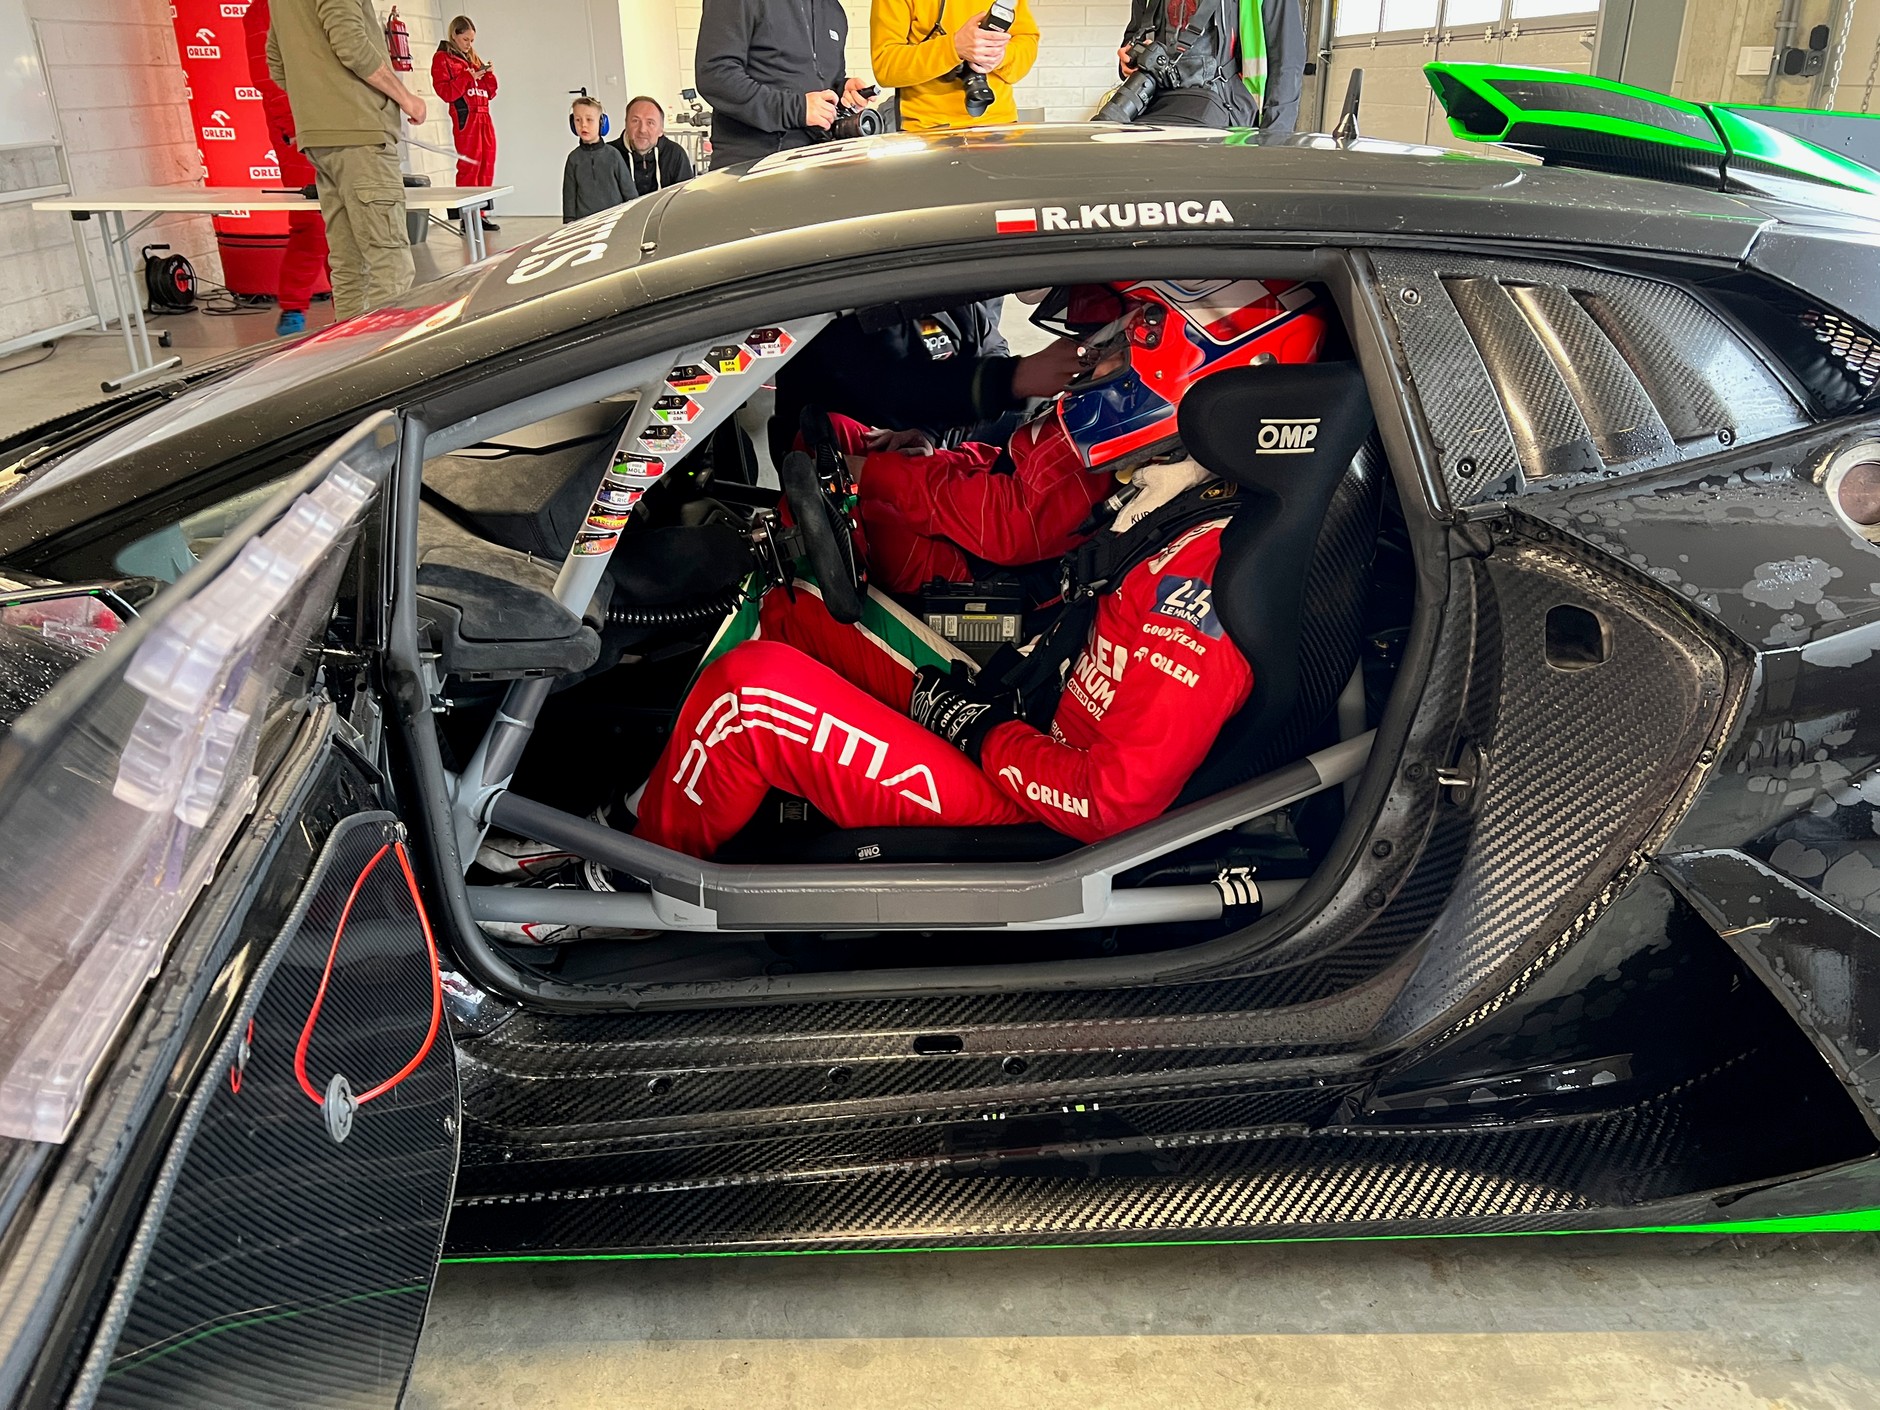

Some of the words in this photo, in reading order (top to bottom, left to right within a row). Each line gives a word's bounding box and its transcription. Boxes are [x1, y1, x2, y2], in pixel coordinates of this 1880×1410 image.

[223, 6, 248, 15] ORL
[188, 48, 218, 57] ORLEN
[238, 89, 262, 98] ORL
[204, 129, 234, 138] ORLEN
[252, 168, 281, 177] ORLE
[1042, 199, 1234, 231] R.KUBICA
[1257, 423, 1319, 450] OMP
[1150, 652, 1200, 688] ORLEN
[941, 699, 967, 728] ORLEN
[1067, 679, 1088, 706] ORLEN
[1086, 701, 1105, 722] OIL
[672, 686, 942, 815] PREMA
[1026, 781, 1088, 818] ORLEN
[857, 846, 880, 859] OMP
